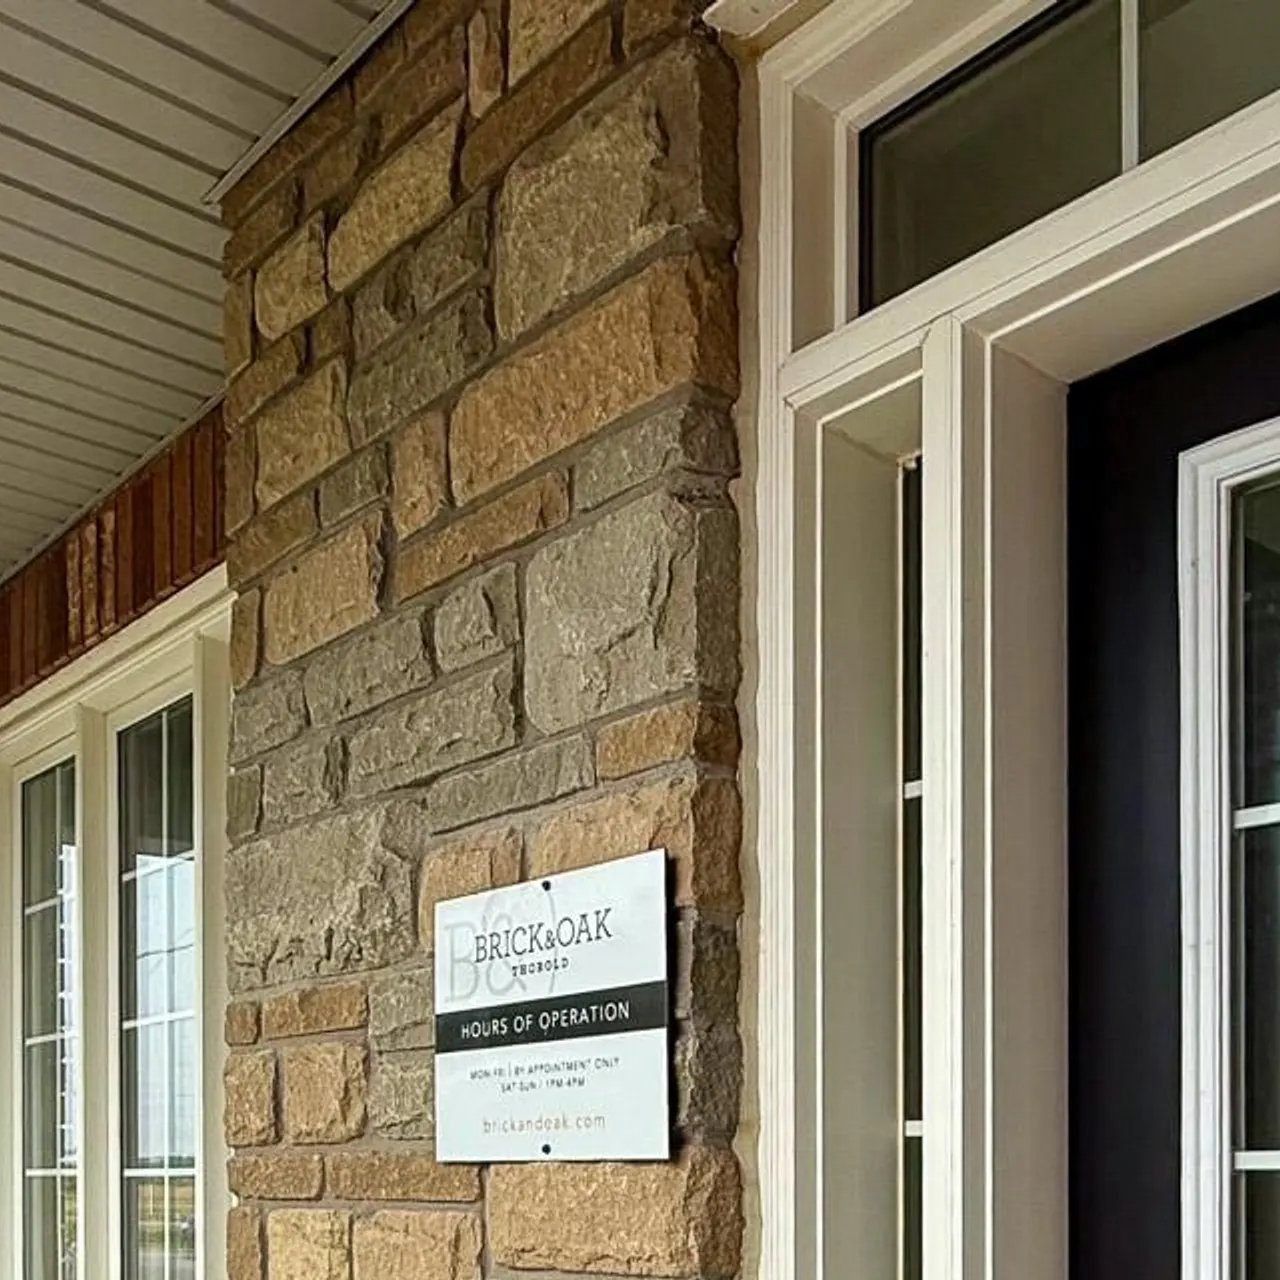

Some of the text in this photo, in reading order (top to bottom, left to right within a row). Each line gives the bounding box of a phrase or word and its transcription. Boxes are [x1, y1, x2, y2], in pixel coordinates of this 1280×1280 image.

[474, 907, 613, 963] BRICK&OAK
[461, 1001, 630, 1039] HOURS OF OPERATION
[528, 1057, 591, 1075] APPOINTMENT
